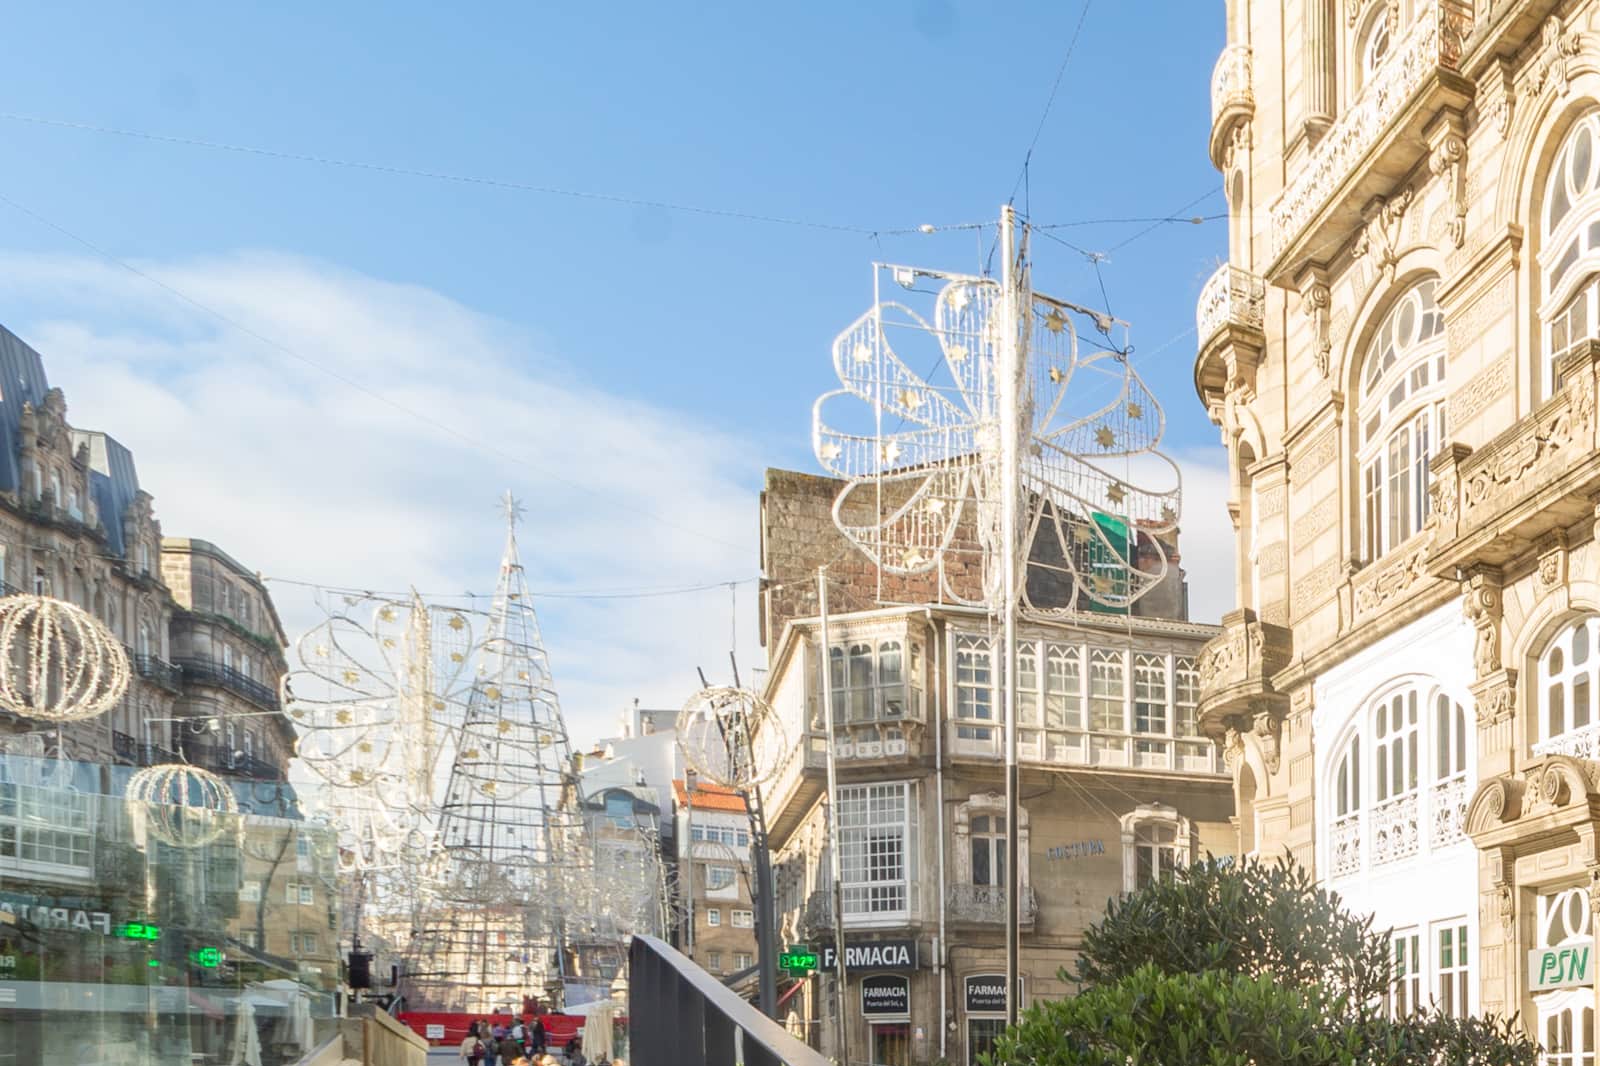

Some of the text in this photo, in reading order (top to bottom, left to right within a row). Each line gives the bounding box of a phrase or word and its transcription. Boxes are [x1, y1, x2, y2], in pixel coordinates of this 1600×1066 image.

[1539, 946, 1589, 985] PSN
[864, 986, 906, 998] FARMACIA
[968, 985, 1008, 996] FARMAC
